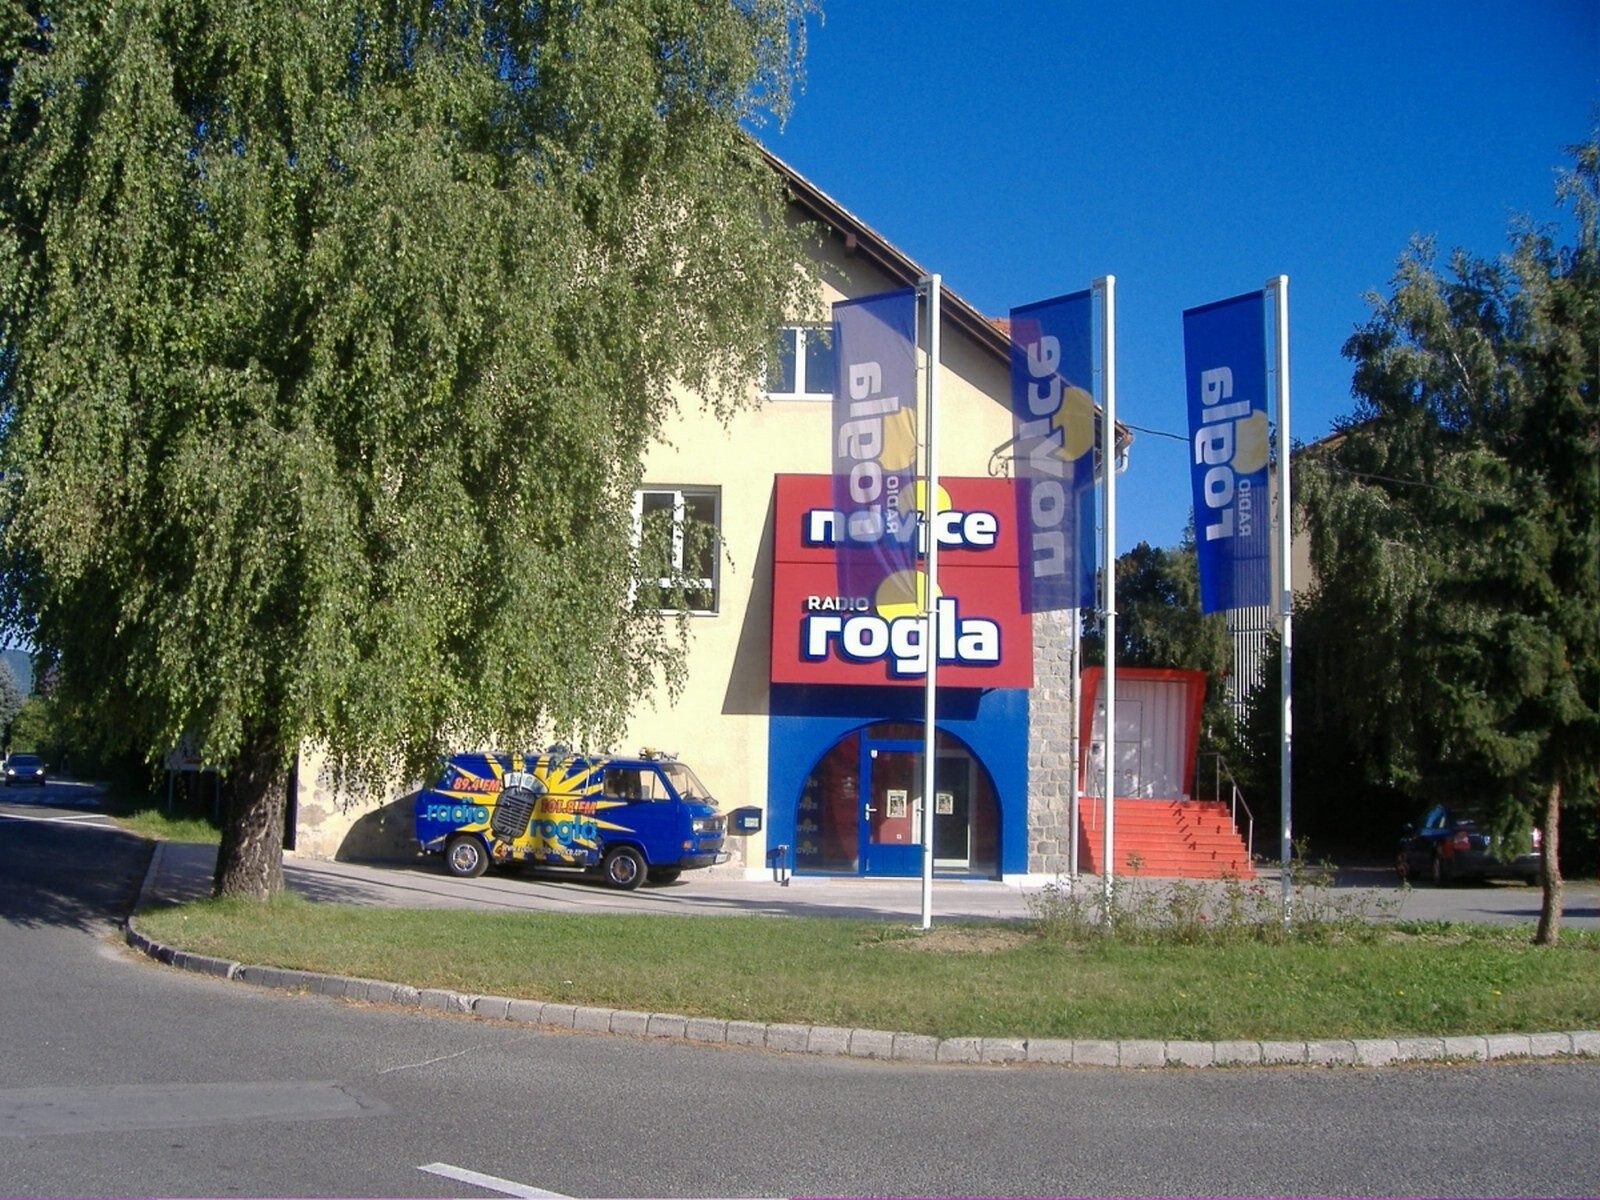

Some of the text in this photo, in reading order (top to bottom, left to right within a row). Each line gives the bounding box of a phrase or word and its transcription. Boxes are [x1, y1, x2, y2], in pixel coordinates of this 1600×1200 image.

[807, 595, 869, 611] RADIO
[807, 598, 1000, 674] rogla
[427, 796, 490, 825] radio
[530, 815, 597, 846] rogla
